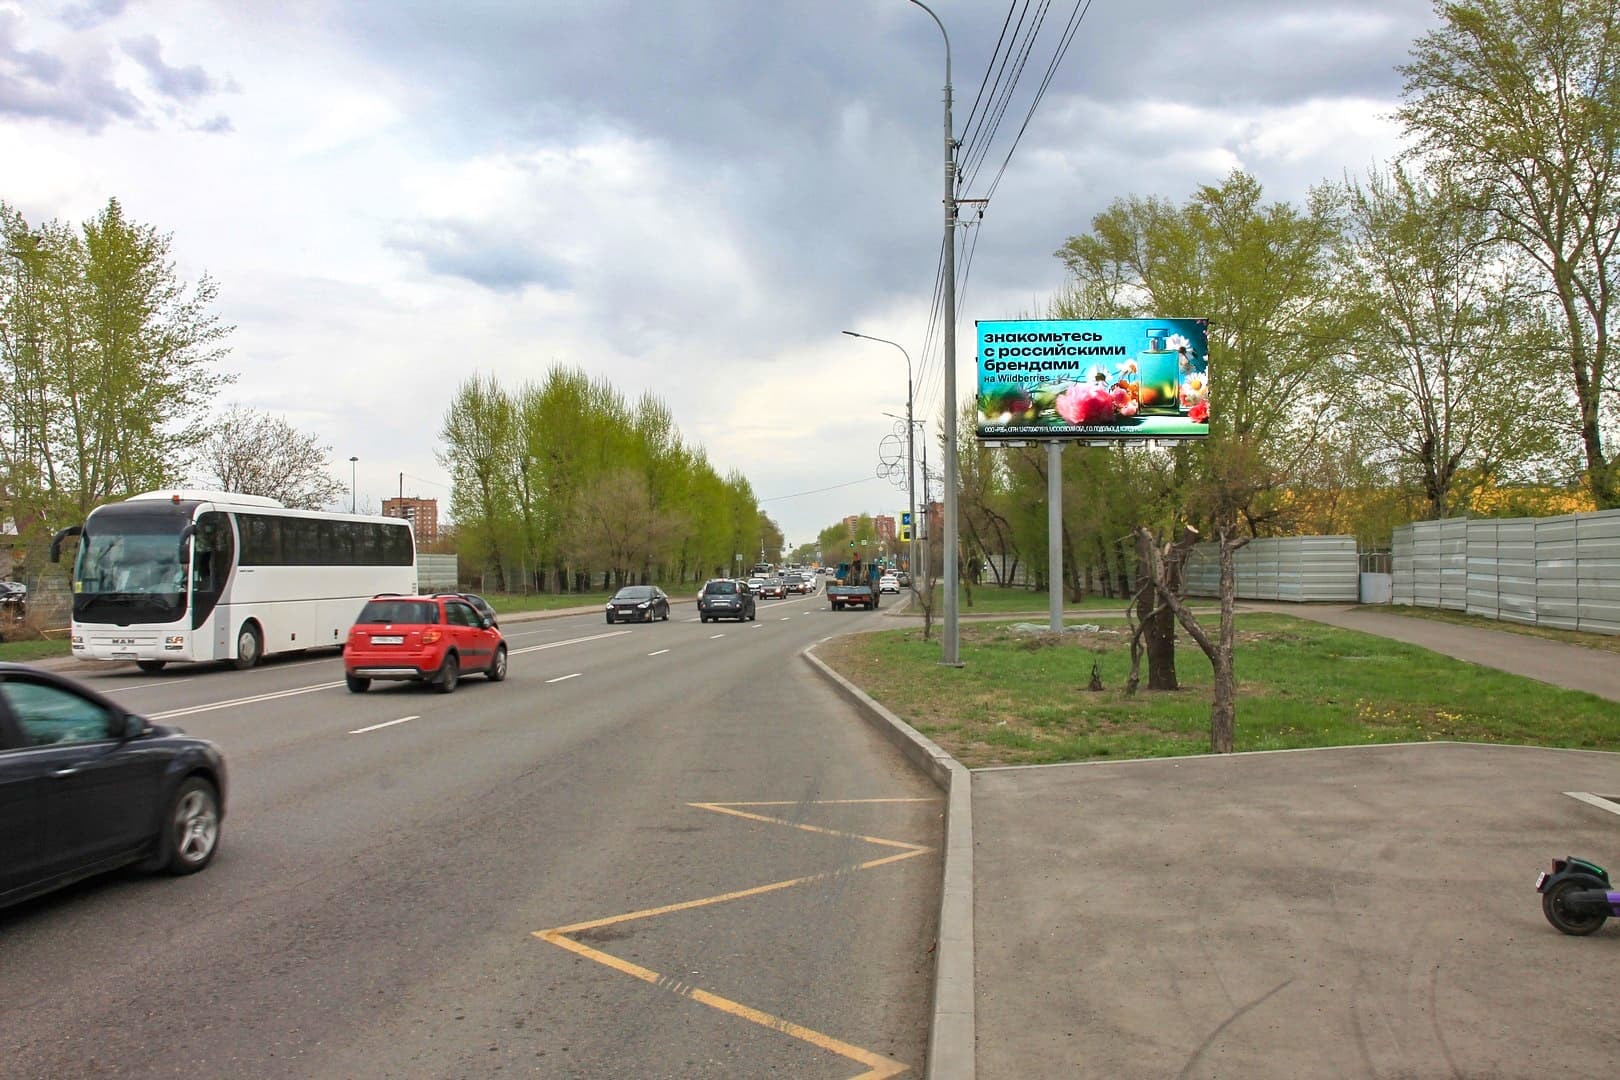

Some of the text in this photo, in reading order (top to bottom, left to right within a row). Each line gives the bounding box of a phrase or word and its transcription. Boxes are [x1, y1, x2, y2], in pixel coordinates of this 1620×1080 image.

[984, 332, 1103, 343] знакомьтесь
[984, 343, 1126, 359] с российскими
[984, 359, 1079, 373] брендами
[997, 374, 1050, 383] Wildberries
